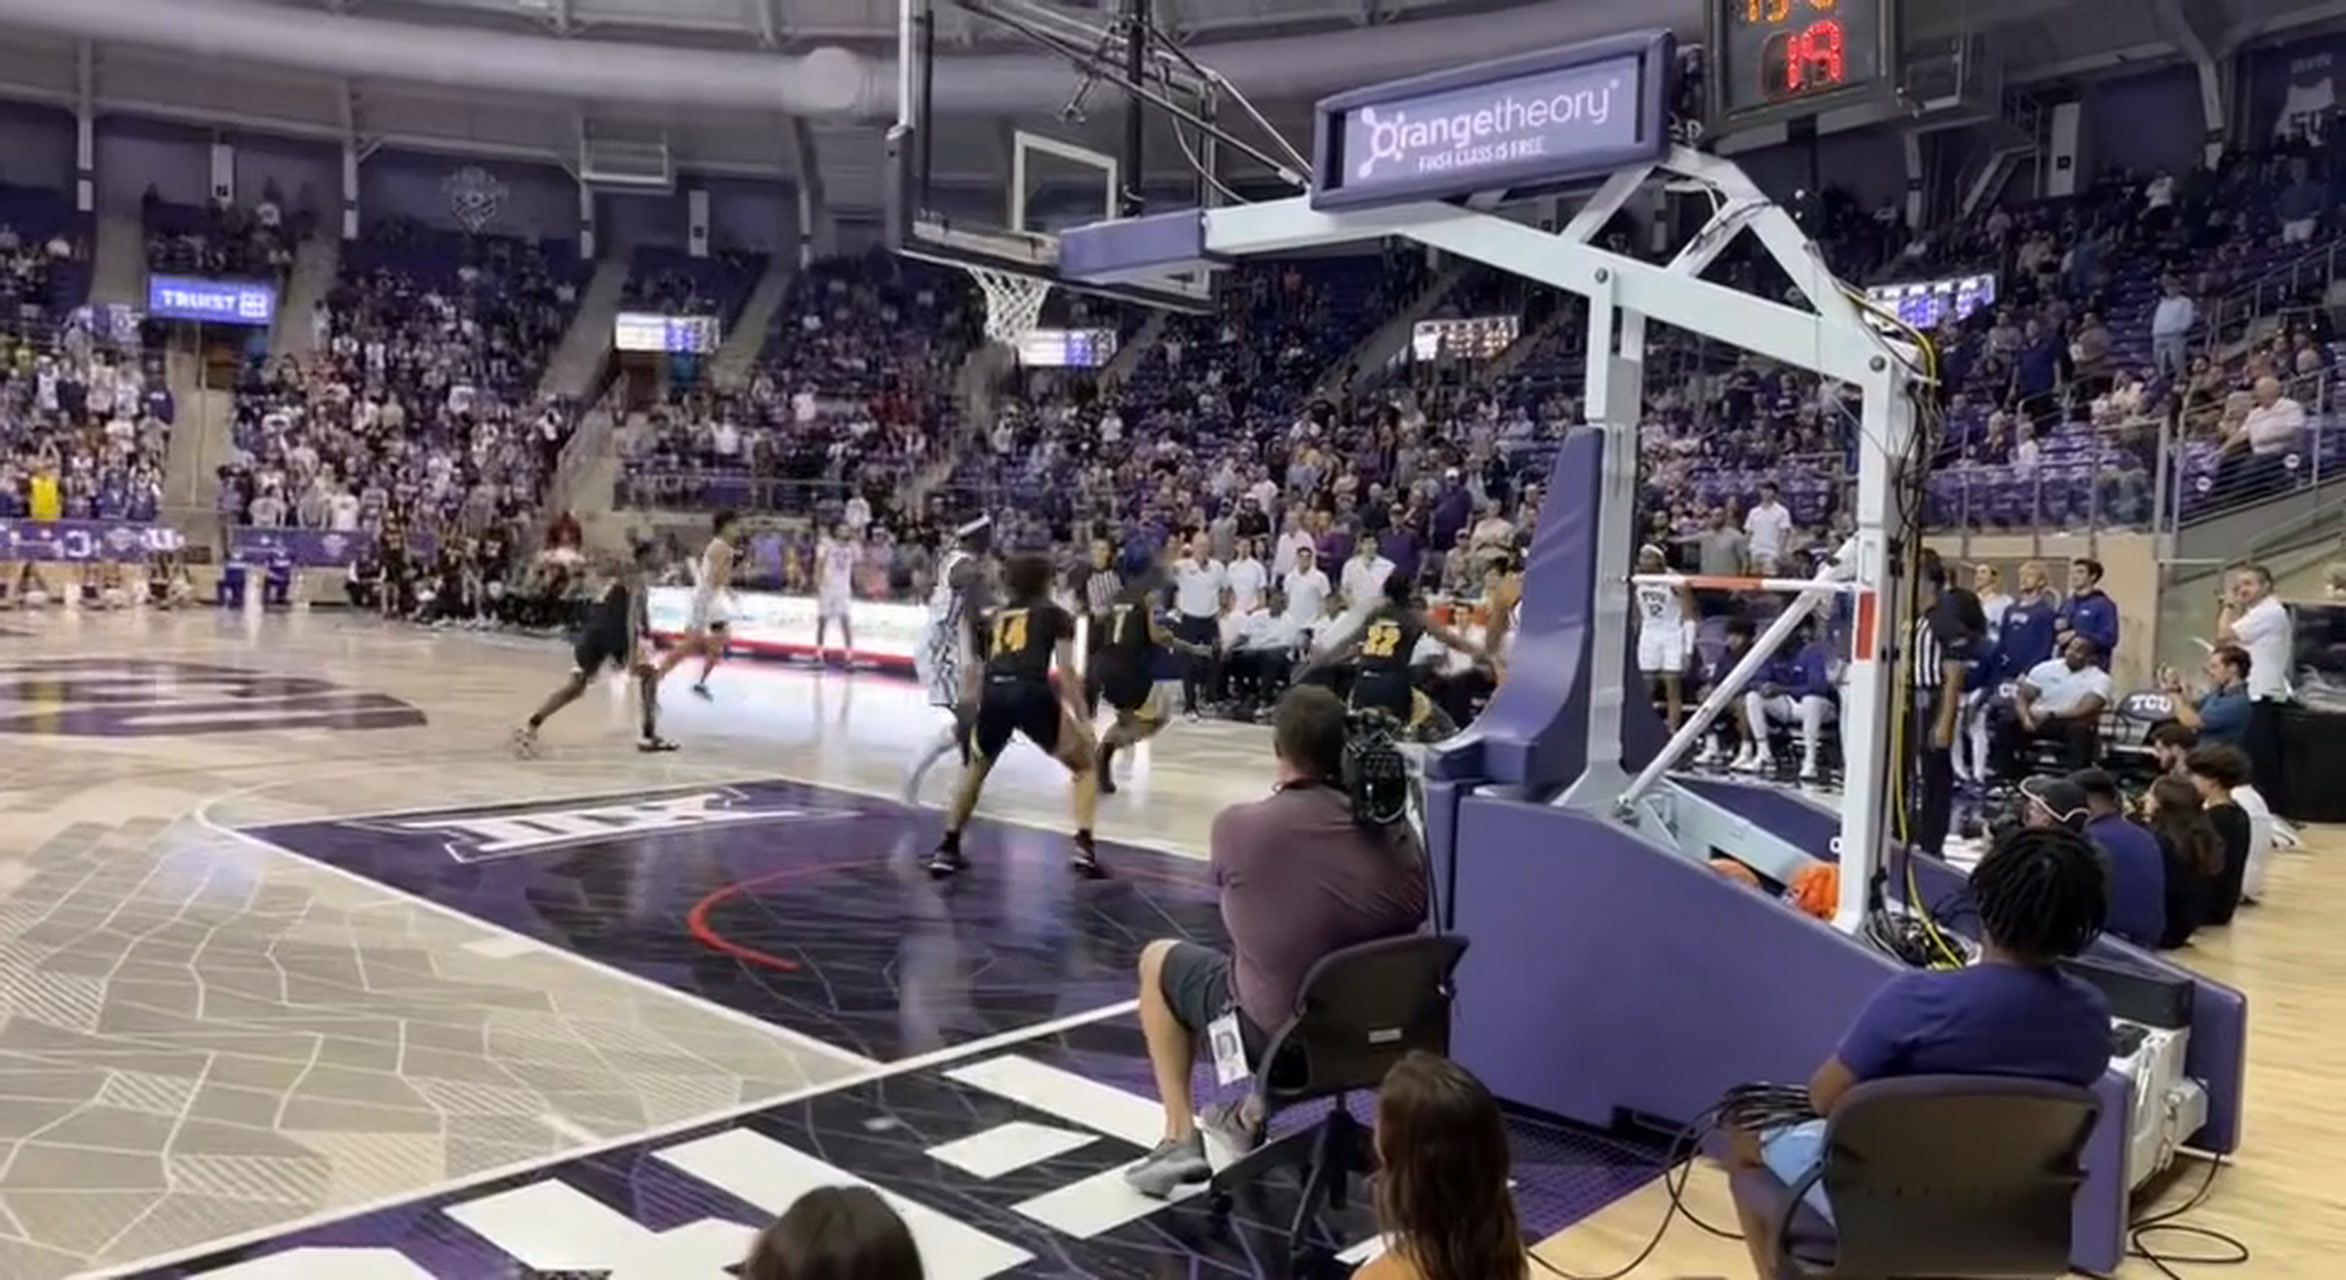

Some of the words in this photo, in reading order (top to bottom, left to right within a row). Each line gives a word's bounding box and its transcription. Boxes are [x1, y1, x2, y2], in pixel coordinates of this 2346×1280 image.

[1786, 22, 1842, 90] 19
[1510, 135, 1546, 158] FREE
[162, 289, 235, 311] TRUIST
[2130, 694, 2172, 713] TCU
